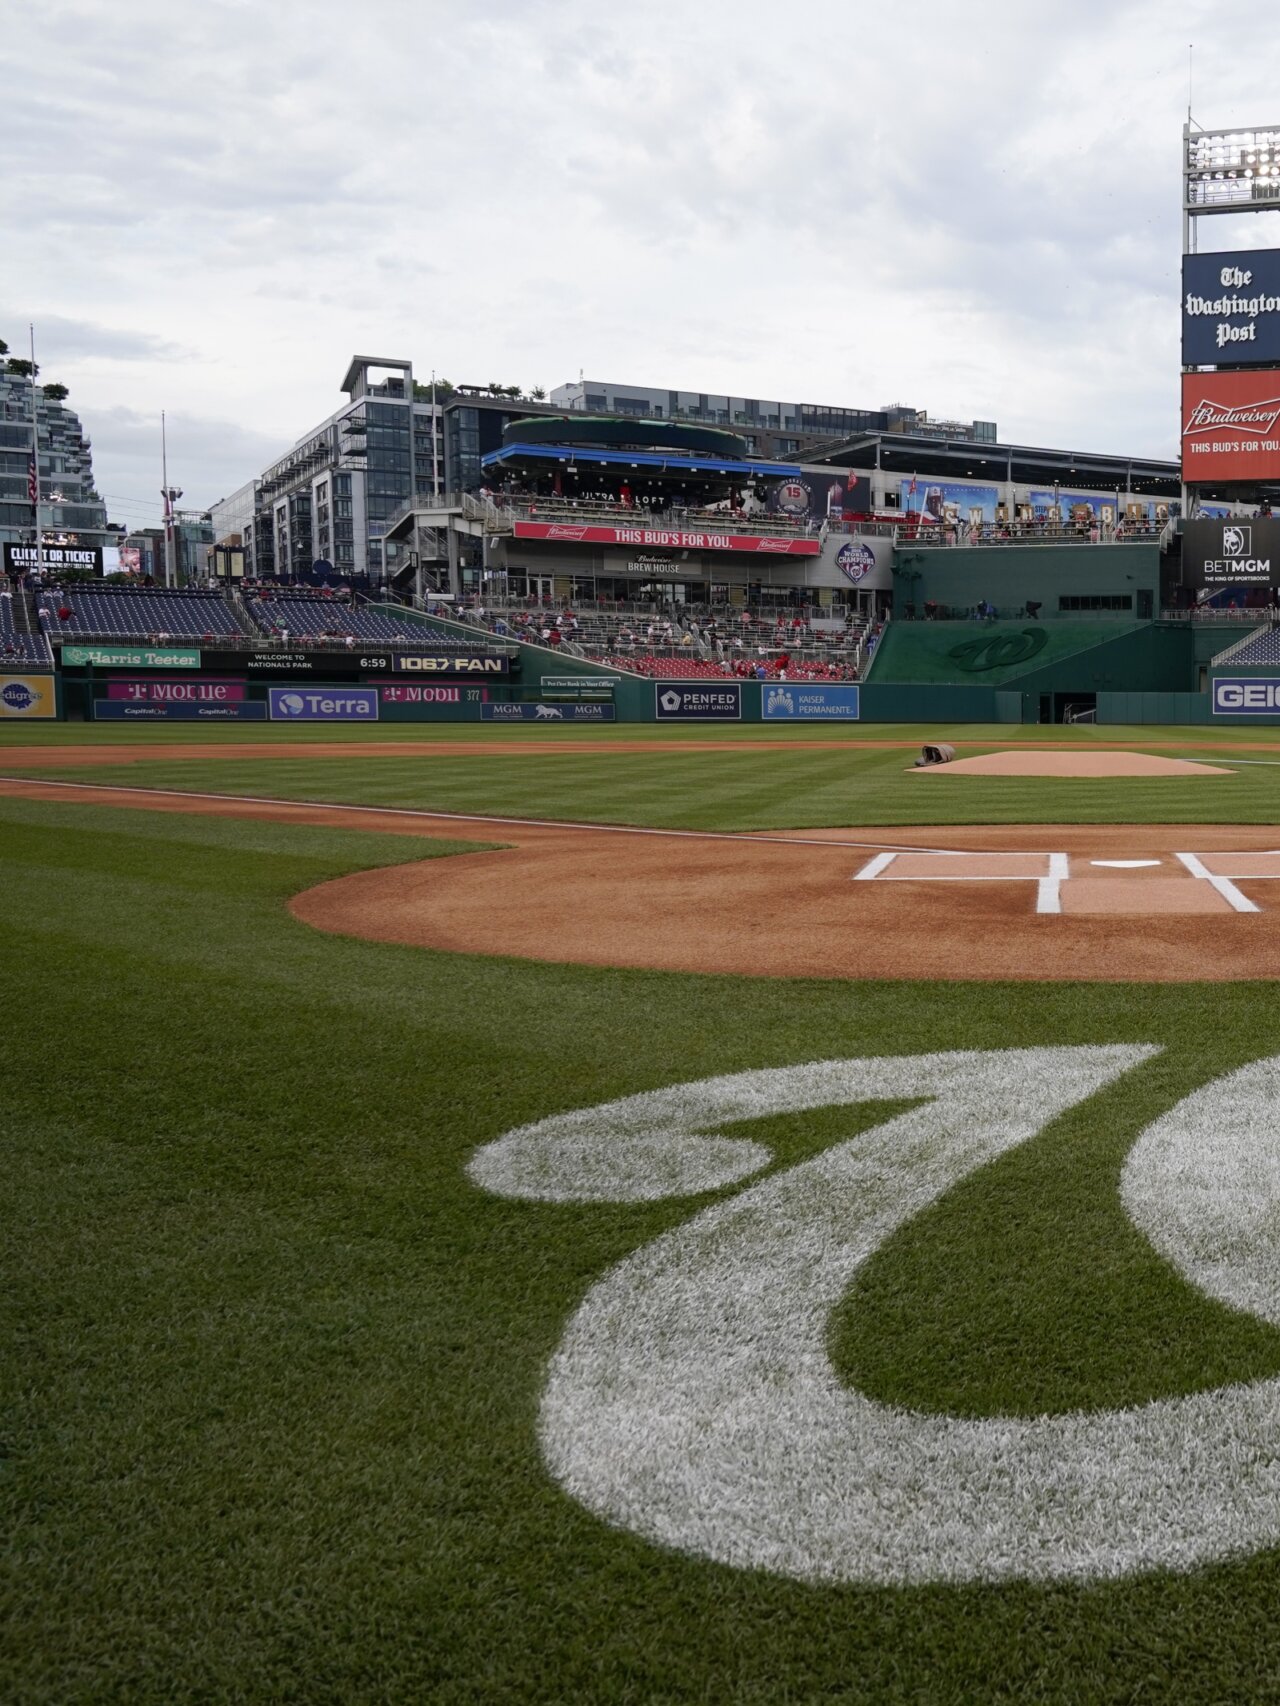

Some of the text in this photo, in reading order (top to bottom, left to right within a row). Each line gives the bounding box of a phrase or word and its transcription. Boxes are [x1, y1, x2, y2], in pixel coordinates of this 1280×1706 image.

[1220, 266, 1252, 288] The
[1216, 322, 1256, 348] Post
[1191, 407, 1278, 425] Budweiser
[1191, 440, 1280, 453] THIS BUD'S FOR YOU.
[786, 486, 801, 498] 15
[635, 495, 664, 504] LOFT
[614, 529, 641, 543] THIS
[644, 531, 679, 545] BUD'S
[682, 534, 703, 546] FOR
[707, 535, 732, 548] YOU.
[50, 549, 96, 564] OR TICKET
[838, 556, 874, 565] CHAMPIONS
[628, 562, 680, 573] BREW HOUSE
[1204, 560, 1270, 572] BETMGM
[88, 652, 196, 665] Harris Teeter
[360, 658, 386, 667] 6:59
[455, 658, 502, 671] FAN
[467, 690, 480, 702] 377
[683, 694, 735, 704] PENFED
[799, 696, 824, 704] KAISER
[306, 696, 369, 713] Terra
[493, 705, 602, 714] MGM MGM
[799, 705, 851, 714] PERMANENTE
